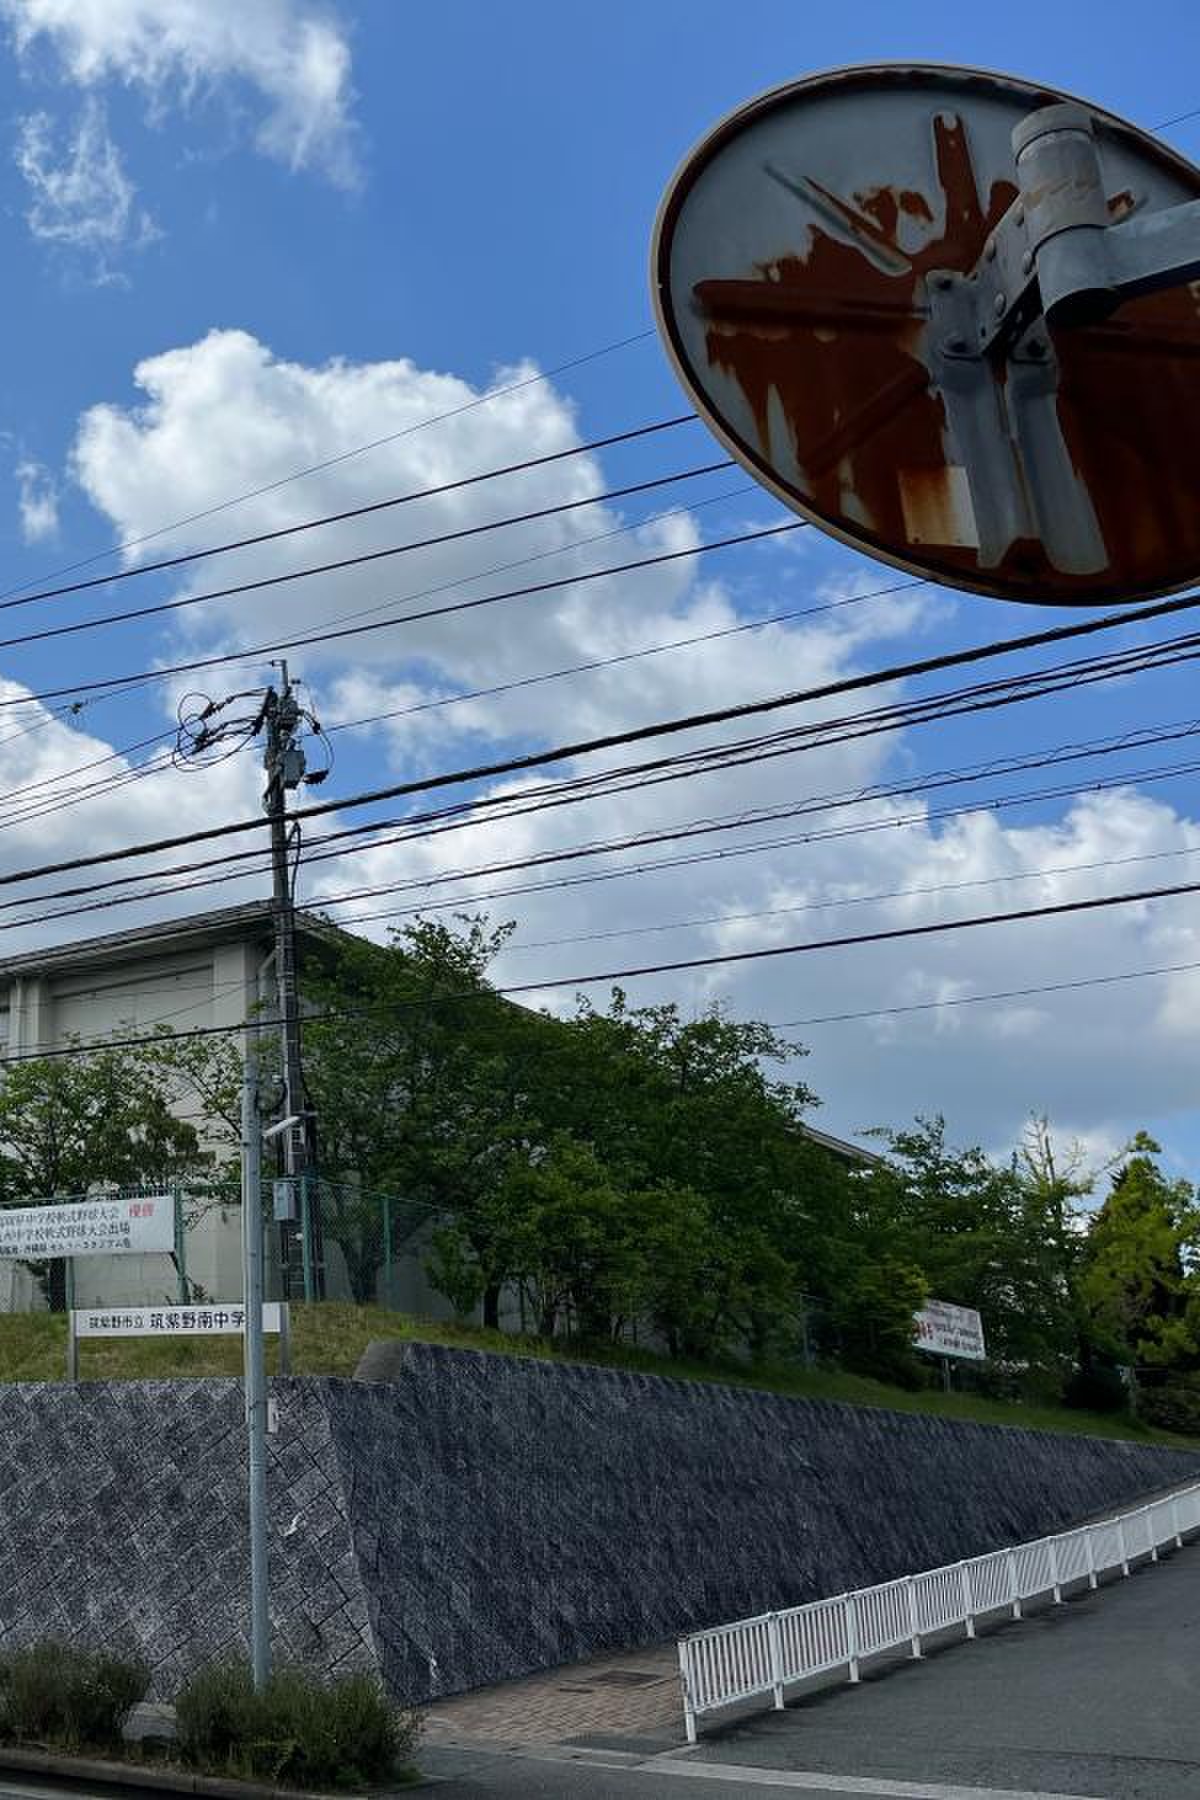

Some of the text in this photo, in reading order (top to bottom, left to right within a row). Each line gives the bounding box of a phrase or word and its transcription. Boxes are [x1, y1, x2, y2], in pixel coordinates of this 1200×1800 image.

[150, 1311, 246, 1329] 筑紫野南中学
